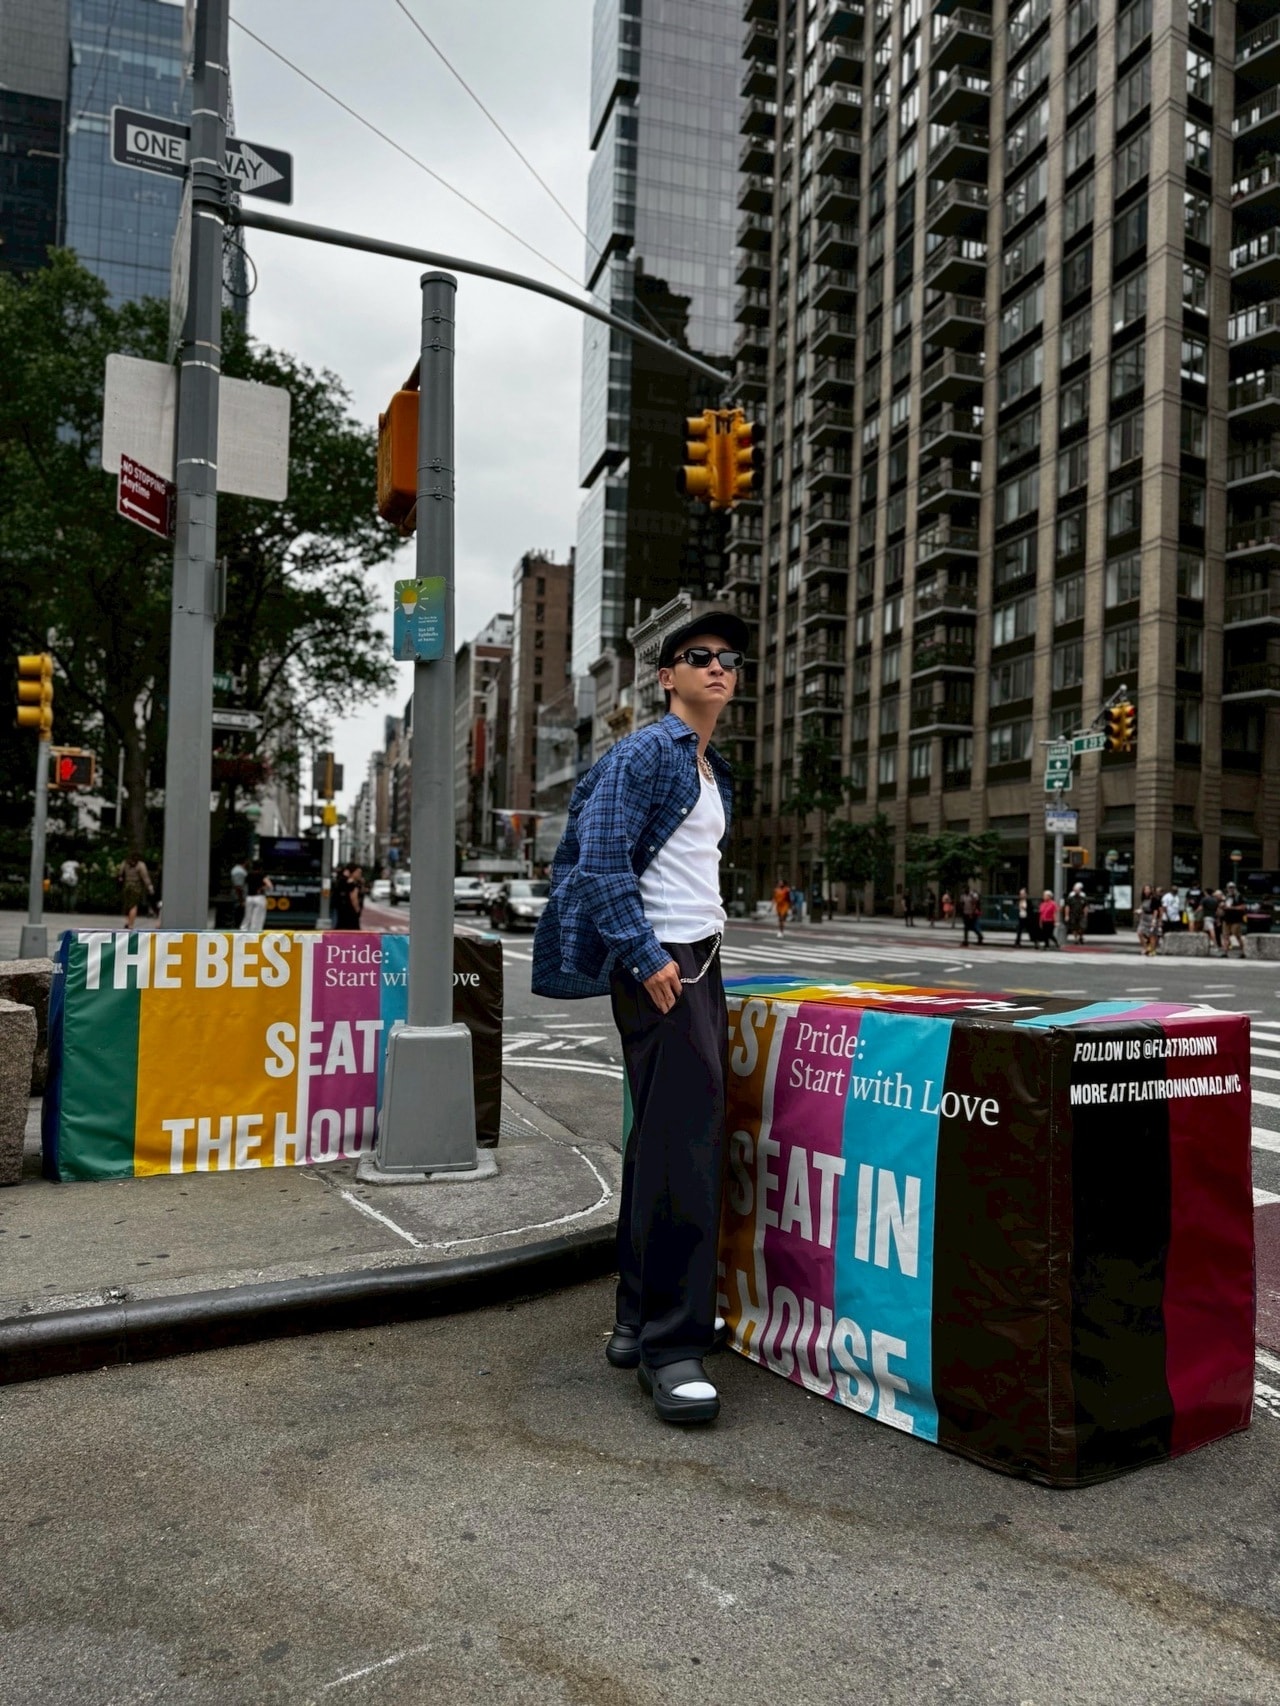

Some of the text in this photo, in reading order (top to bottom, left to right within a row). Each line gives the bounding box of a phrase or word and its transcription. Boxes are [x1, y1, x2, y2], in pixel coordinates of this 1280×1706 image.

[134, 131, 182, 161] ONE
[122, 460, 166, 495] NO STOPPING
[122, 474, 151, 500] Anytime
[78, 932, 184, 990] THE
[195, 932, 323, 989] BEST
[326, 945, 390, 965] Pride:
[325, 967, 378, 987] Start
[382, 967, 409, 987] wi
[265, 1020, 385, 1078] SEAT
[795, 1022, 867, 1060] Pride:
[1073, 1036, 1218, 1062] FOLLOW US @FLATIRONNY
[789, 1059, 1000, 1127] Start with Love
[1070, 1074, 1242, 1105] MORE AT FLATIRONNOMAD.NYC
[162, 1106, 381, 1174] THE HOU
[729, 1130, 921, 1279] SEAT IN
[736, 1267, 915, 1433] HOUSE
